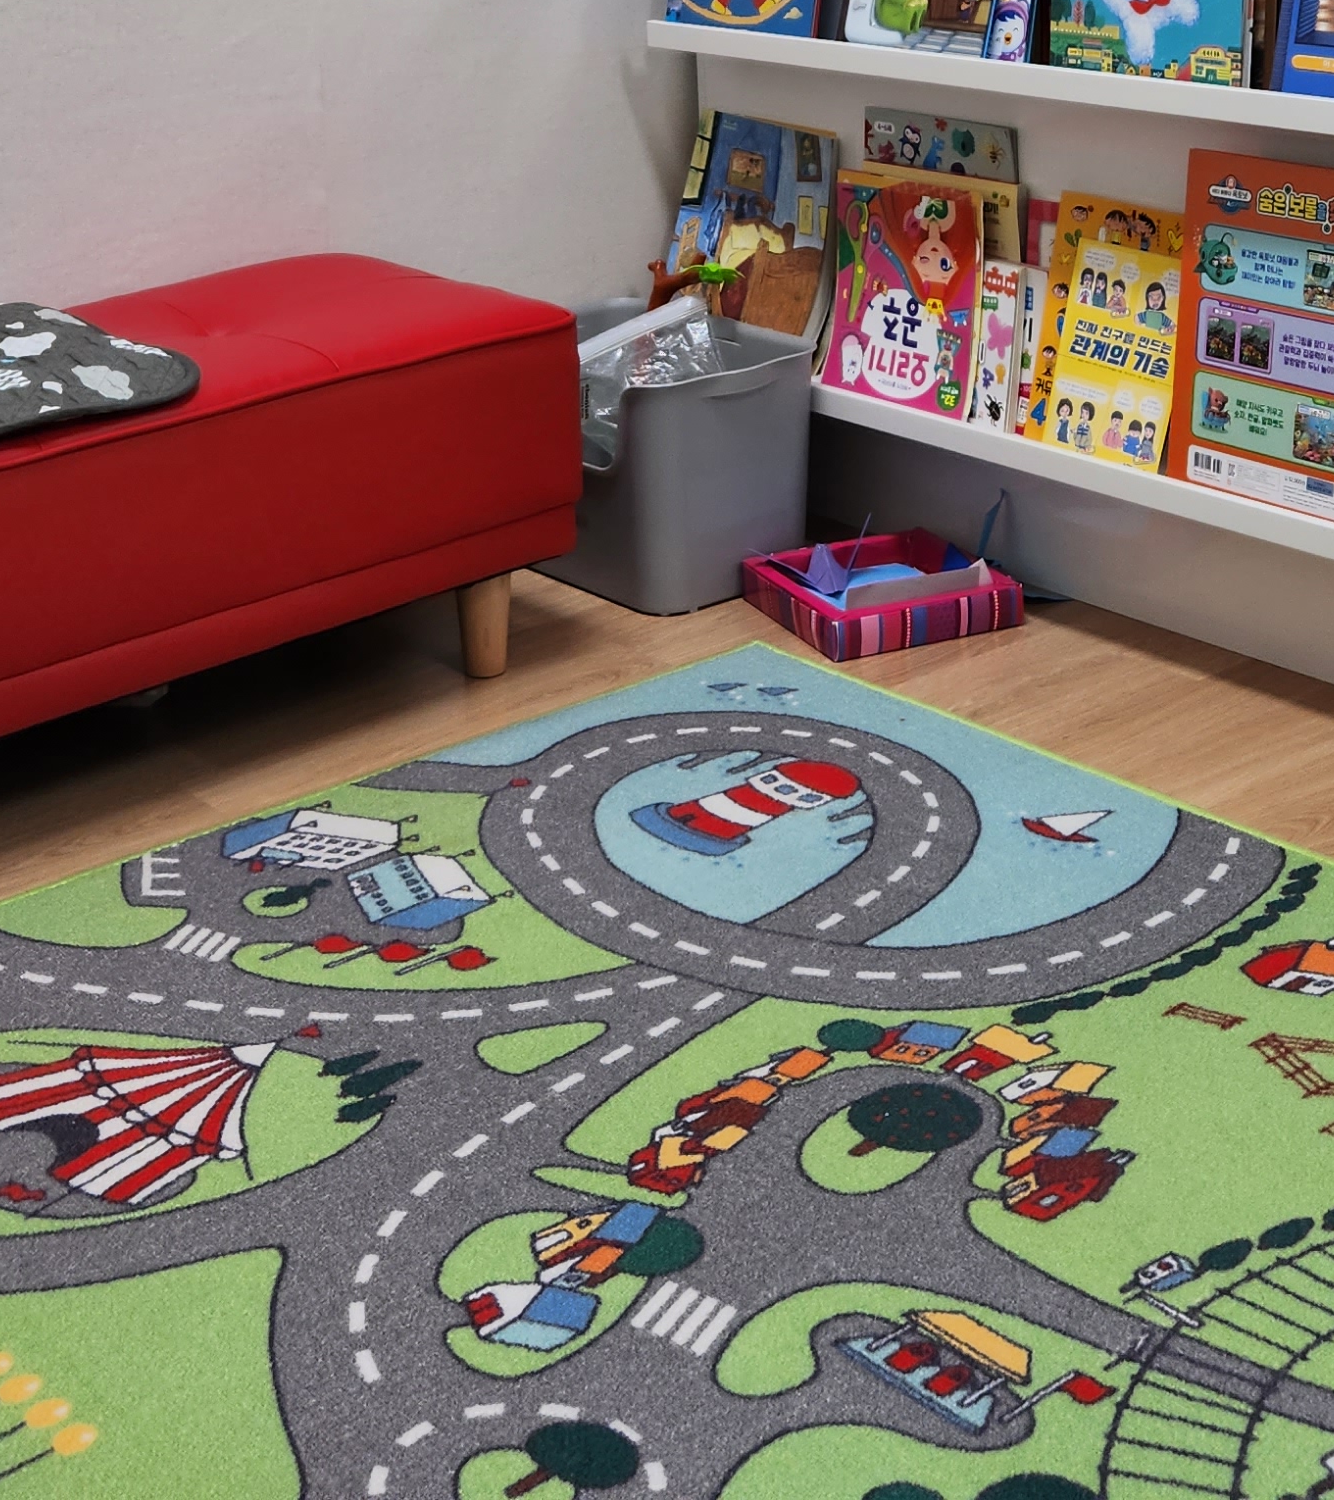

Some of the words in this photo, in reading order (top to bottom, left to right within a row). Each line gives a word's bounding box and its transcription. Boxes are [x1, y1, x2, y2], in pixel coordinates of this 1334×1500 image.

[1259, 189, 1287, 214] 숨은
[1070, 333, 1129, 368] 관계의
[1133, 350, 1170, 379] 기술
[1137, 336, 1172, 356] 만드는
